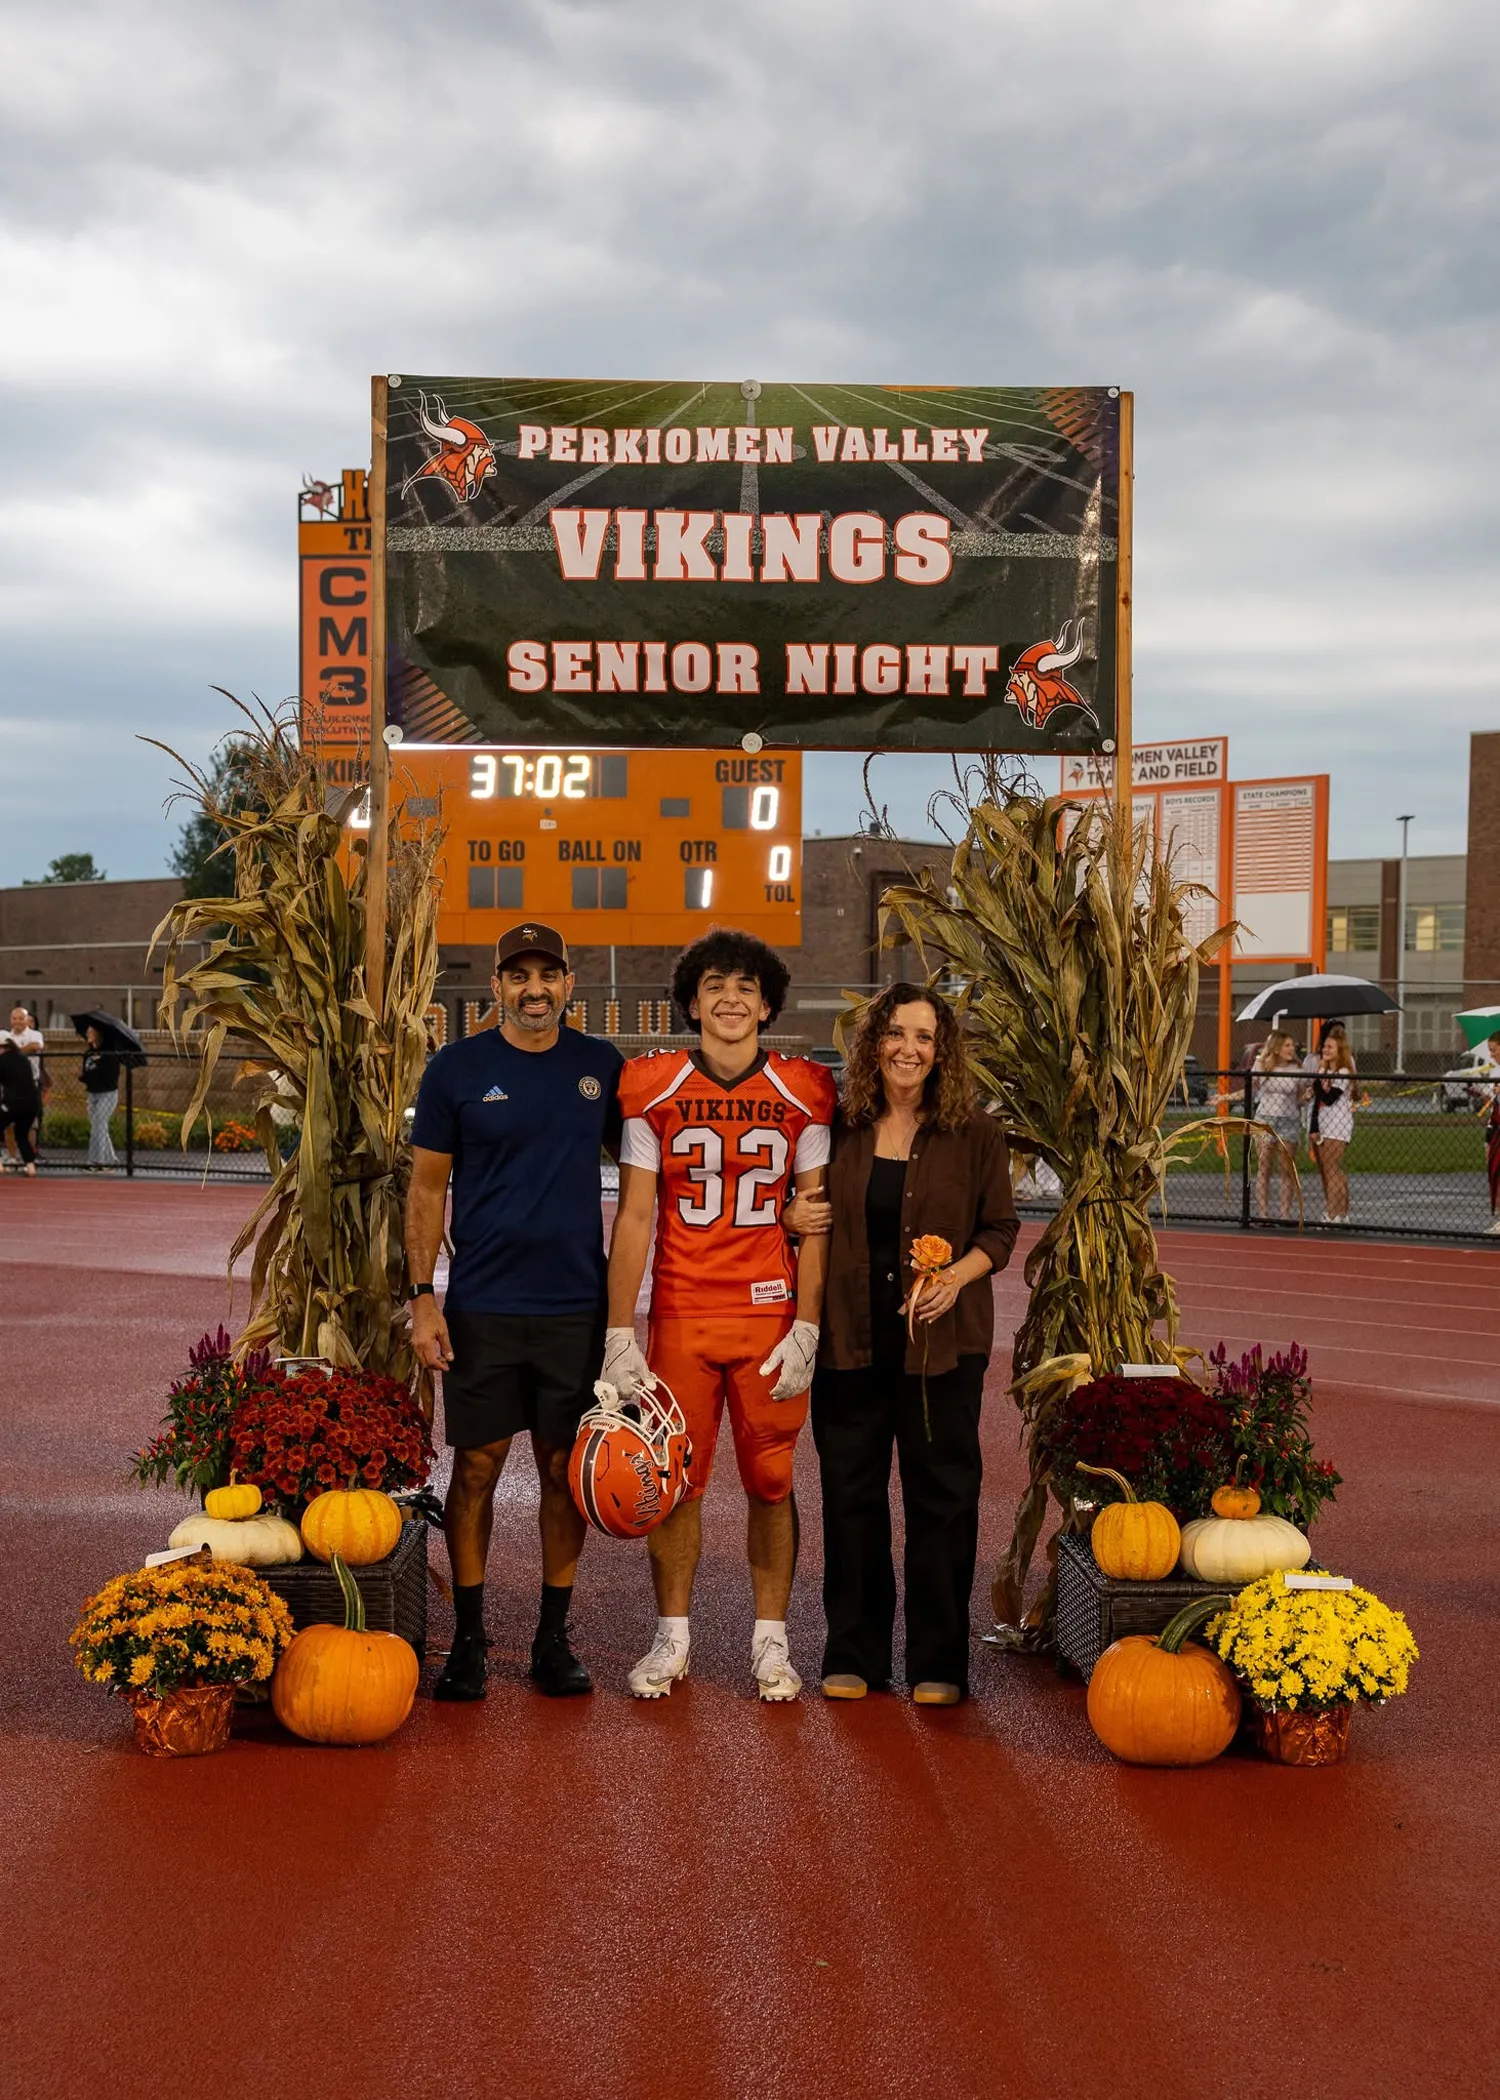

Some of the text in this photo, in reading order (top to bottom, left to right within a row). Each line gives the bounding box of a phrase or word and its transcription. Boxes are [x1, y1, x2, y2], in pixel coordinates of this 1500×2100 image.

[517, 424, 989, 464] PERKIOMEN VALLEY
[549, 508, 953, 586] VIKINGS
[506, 639, 1000, 696] SENIOR NIGHT
[1166, 744, 1219, 761] VALLEY
[470, 755, 590, 799] 37:02
[715, 759, 786, 783] GUEST
[1138, 765, 1170, 781] AND
[1174, 760, 1217, 778] FIELD
[1243, 787, 1307, 799] STATE CHAMPIONS
[750, 786, 780, 830] 0
[468, 840, 526, 862] TO GO
[558, 840, 642, 862] BALL ON
[680, 840, 718, 864] QTR
[768, 845, 792, 882] 0
[700, 868, 713, 909] 1
[764, 884, 796, 903] TOL
[482, 1093, 509, 1102] adidas
[675, 1099, 788, 1123] VIKINGS
[670, 1124, 790, 1229] 32
[622, 1449, 662, 1527] Vikings
